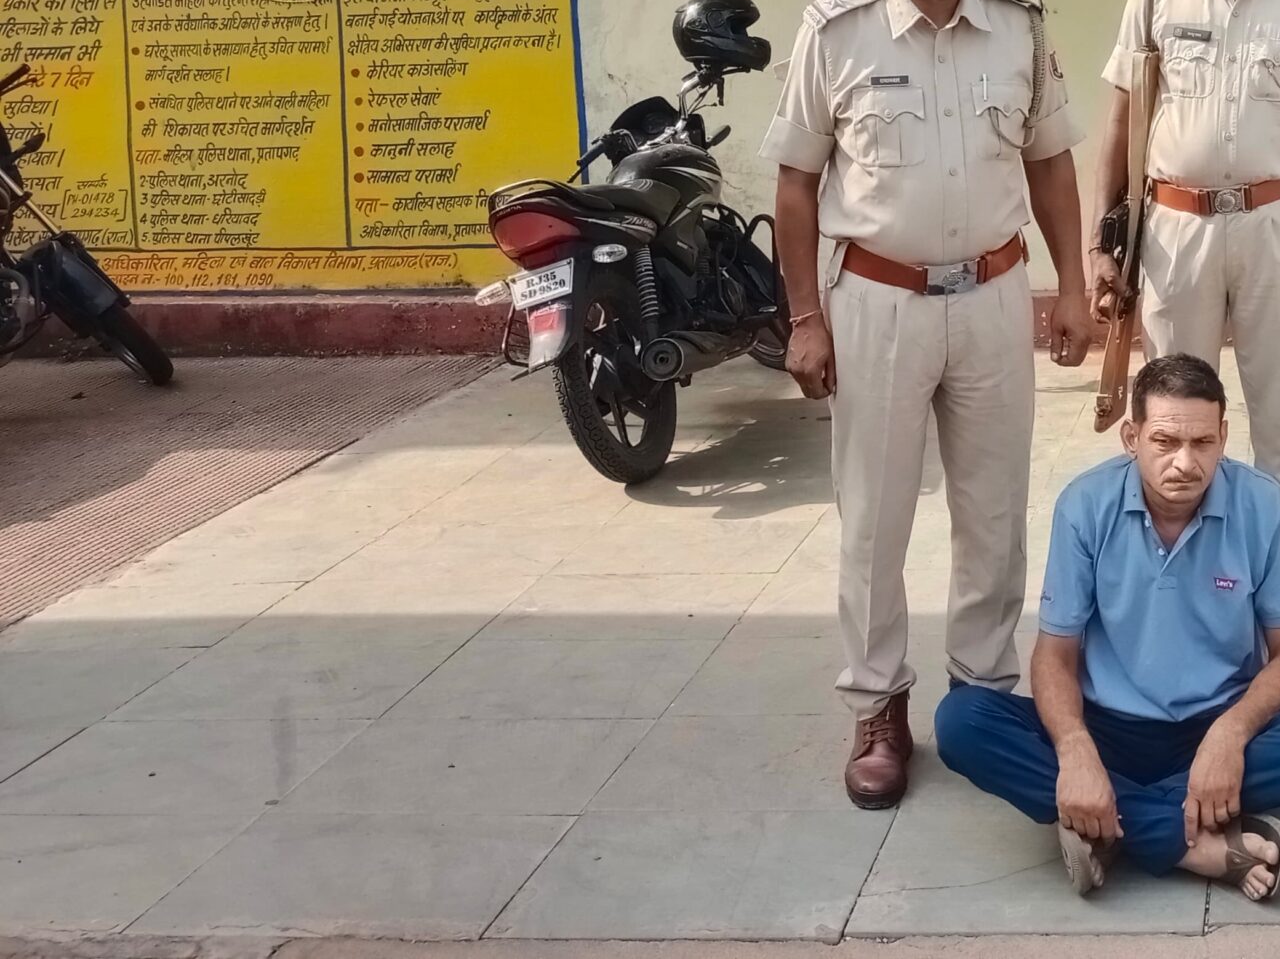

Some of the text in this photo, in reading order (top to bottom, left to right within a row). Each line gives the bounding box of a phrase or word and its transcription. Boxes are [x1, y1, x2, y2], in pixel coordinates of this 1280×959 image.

[51, 17, 68, 36] के
[146, 14, 174, 32] उनके
[261, 11, 272, 28] के
[452, 10, 466, 26] पर
[77, 39, 103, 61] भी
[434, 32, 451, 51] की
[51, 65, 95, 90] 7 दिन
[187, 91, 216, 112] पुलिस
[240, 96, 251, 110] पर
[297, 90, 331, 111] महिला
[141, 118, 158, 138] की
[163, 118, 210, 137] शिकायत
[212, 123, 227, 136] पर
[198, 142, 227, 165] पुलिस
[416, 142, 457, 158] सलाह
[140, 193, 149, 205] 3
[150, 189, 182, 208] पुलिस
[139, 213, 148, 224] 4
[150, 209, 180, 227] पुलिस
[152, 228, 186, 245] पुलिस
[182, 252, 227, 271] महिला
[525, 271, 557, 289] RJ35
